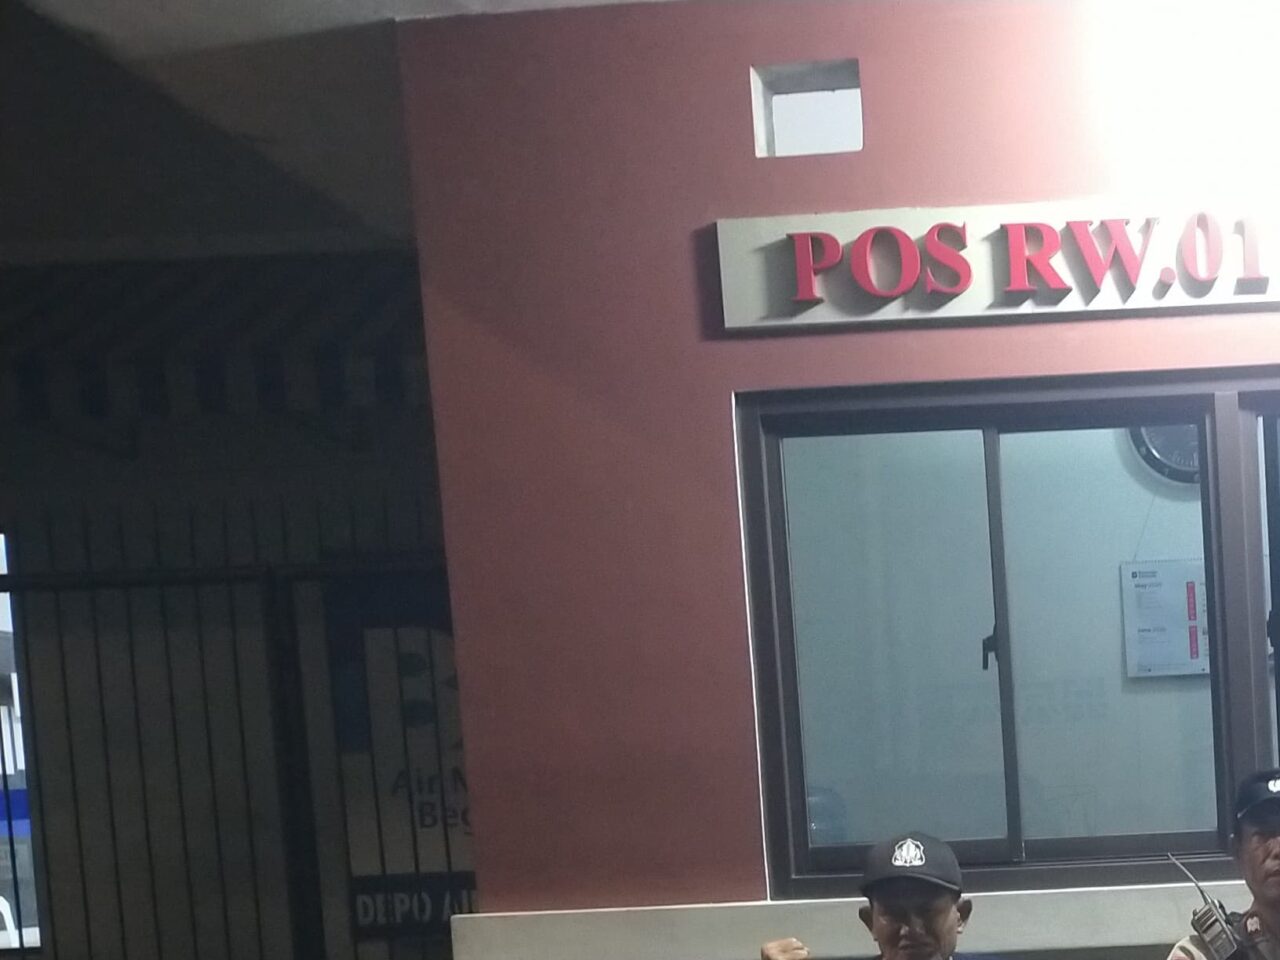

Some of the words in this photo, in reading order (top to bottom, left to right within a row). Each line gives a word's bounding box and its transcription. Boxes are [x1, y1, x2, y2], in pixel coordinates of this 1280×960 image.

[786, 221, 973, 303] POS
[1001, 211, 1270, 301] RW.01
[355, 890, 433, 926] DEPO
[442, 889, 477, 922] AI
